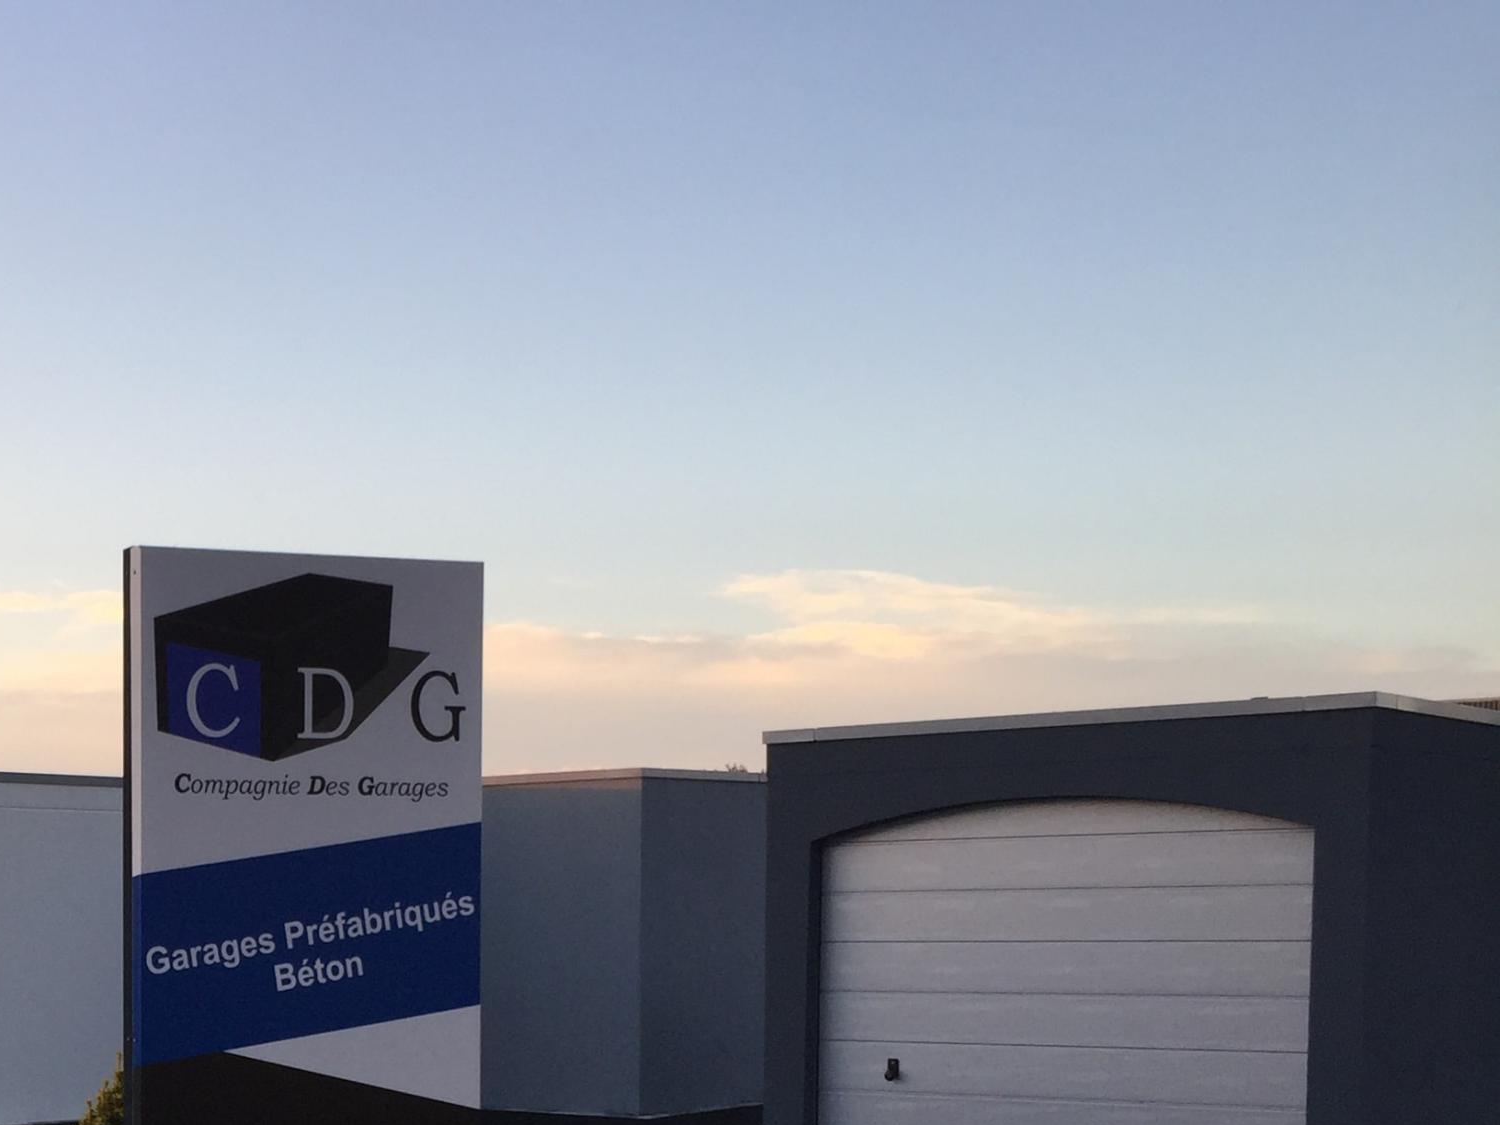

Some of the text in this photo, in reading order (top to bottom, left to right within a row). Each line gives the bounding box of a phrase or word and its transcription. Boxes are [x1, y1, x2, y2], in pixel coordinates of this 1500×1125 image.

[186, 662, 467, 743] C D G
[174, 773, 449, 802] Compagnie Des Garages
[145, 890, 476, 975] Garages Préfabriqués
[273, 953, 365, 992] Béton
